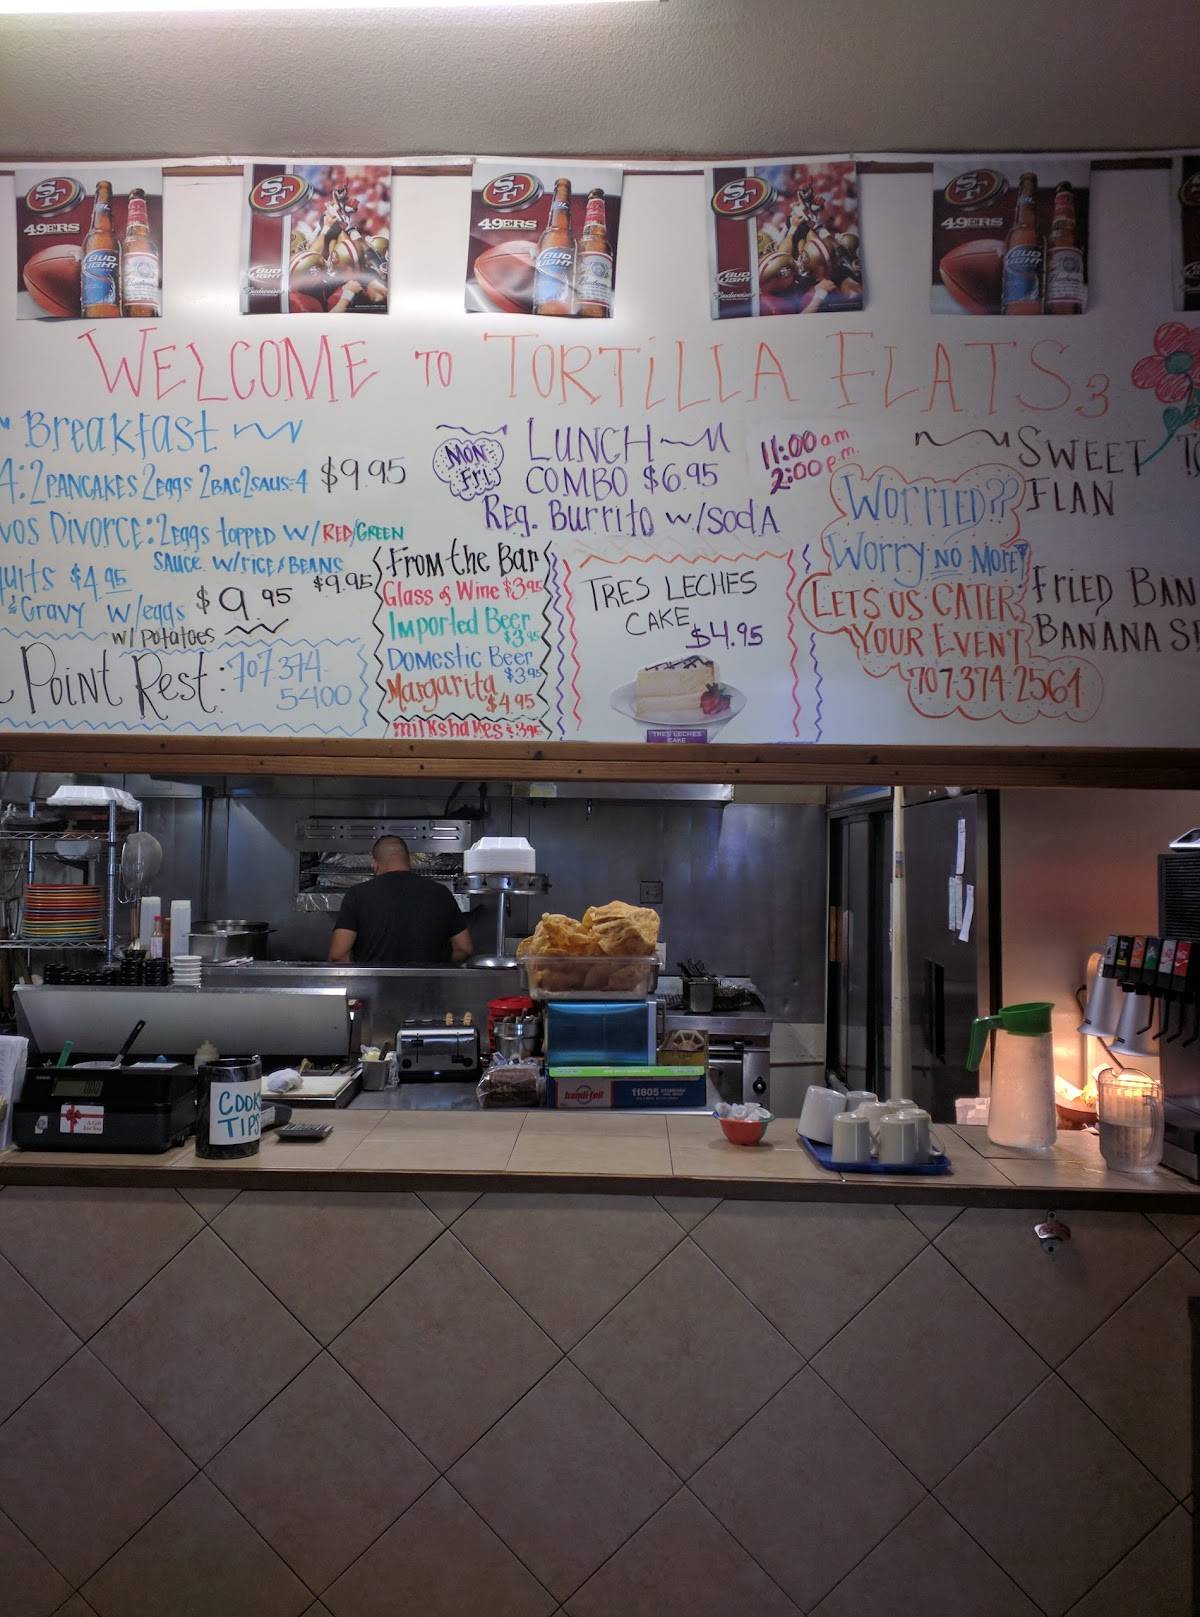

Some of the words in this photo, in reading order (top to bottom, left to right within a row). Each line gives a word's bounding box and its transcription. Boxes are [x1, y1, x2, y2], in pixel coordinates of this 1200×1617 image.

[23, 222, 80, 236] 49ERS
[478, 218, 538, 230] 49ERS
[941, 217, 1004, 230] 49ERS
[77, 327, 380, 402] WELCOME
[414, 350, 453, 388] TO
[20, 409, 219, 460] Breakfast
[526, 417, 654, 463] LUNCH
[760, 430, 817, 470] 11:00
[1018, 425, 1146, 477] SWEET
[320, 456, 407, 493] $9.95
[525, 464, 630, 500] COMBO
[642, 462, 719, 493] $6.95
[769, 459, 822, 495] 2:00
[1025, 476, 1115, 516] FLAN
[549, 499, 655, 537] Burrito
[445, 538, 490, 576] the
[497, 542, 540, 577] Bar
[312, 572, 374, 595] $9.95
[383, 580, 434, 608] Glass
[456, 579, 500, 602] Wine
[578, 575, 651, 612] TRES
[664, 570, 758, 601] LECHES
[812, 579, 880, 621] LETS
[932, 583, 1023, 624] CATER
[20, 596, 86, 629] Gravy
[484, 606, 531, 635] Beer
[625, 606, 690, 636] CAKE
[685, 620, 764, 650] $4.95
[850, 621, 925, 659] YOUR
[933, 623, 1026, 665] EVENT
[1034, 612, 1162, 654] BANANA
[488, 645, 533, 668] Beer
[275, 684, 352, 711] 5400
[386, 671, 498, 713] Margarita
[217, 1113, 260, 1138] TIPS
